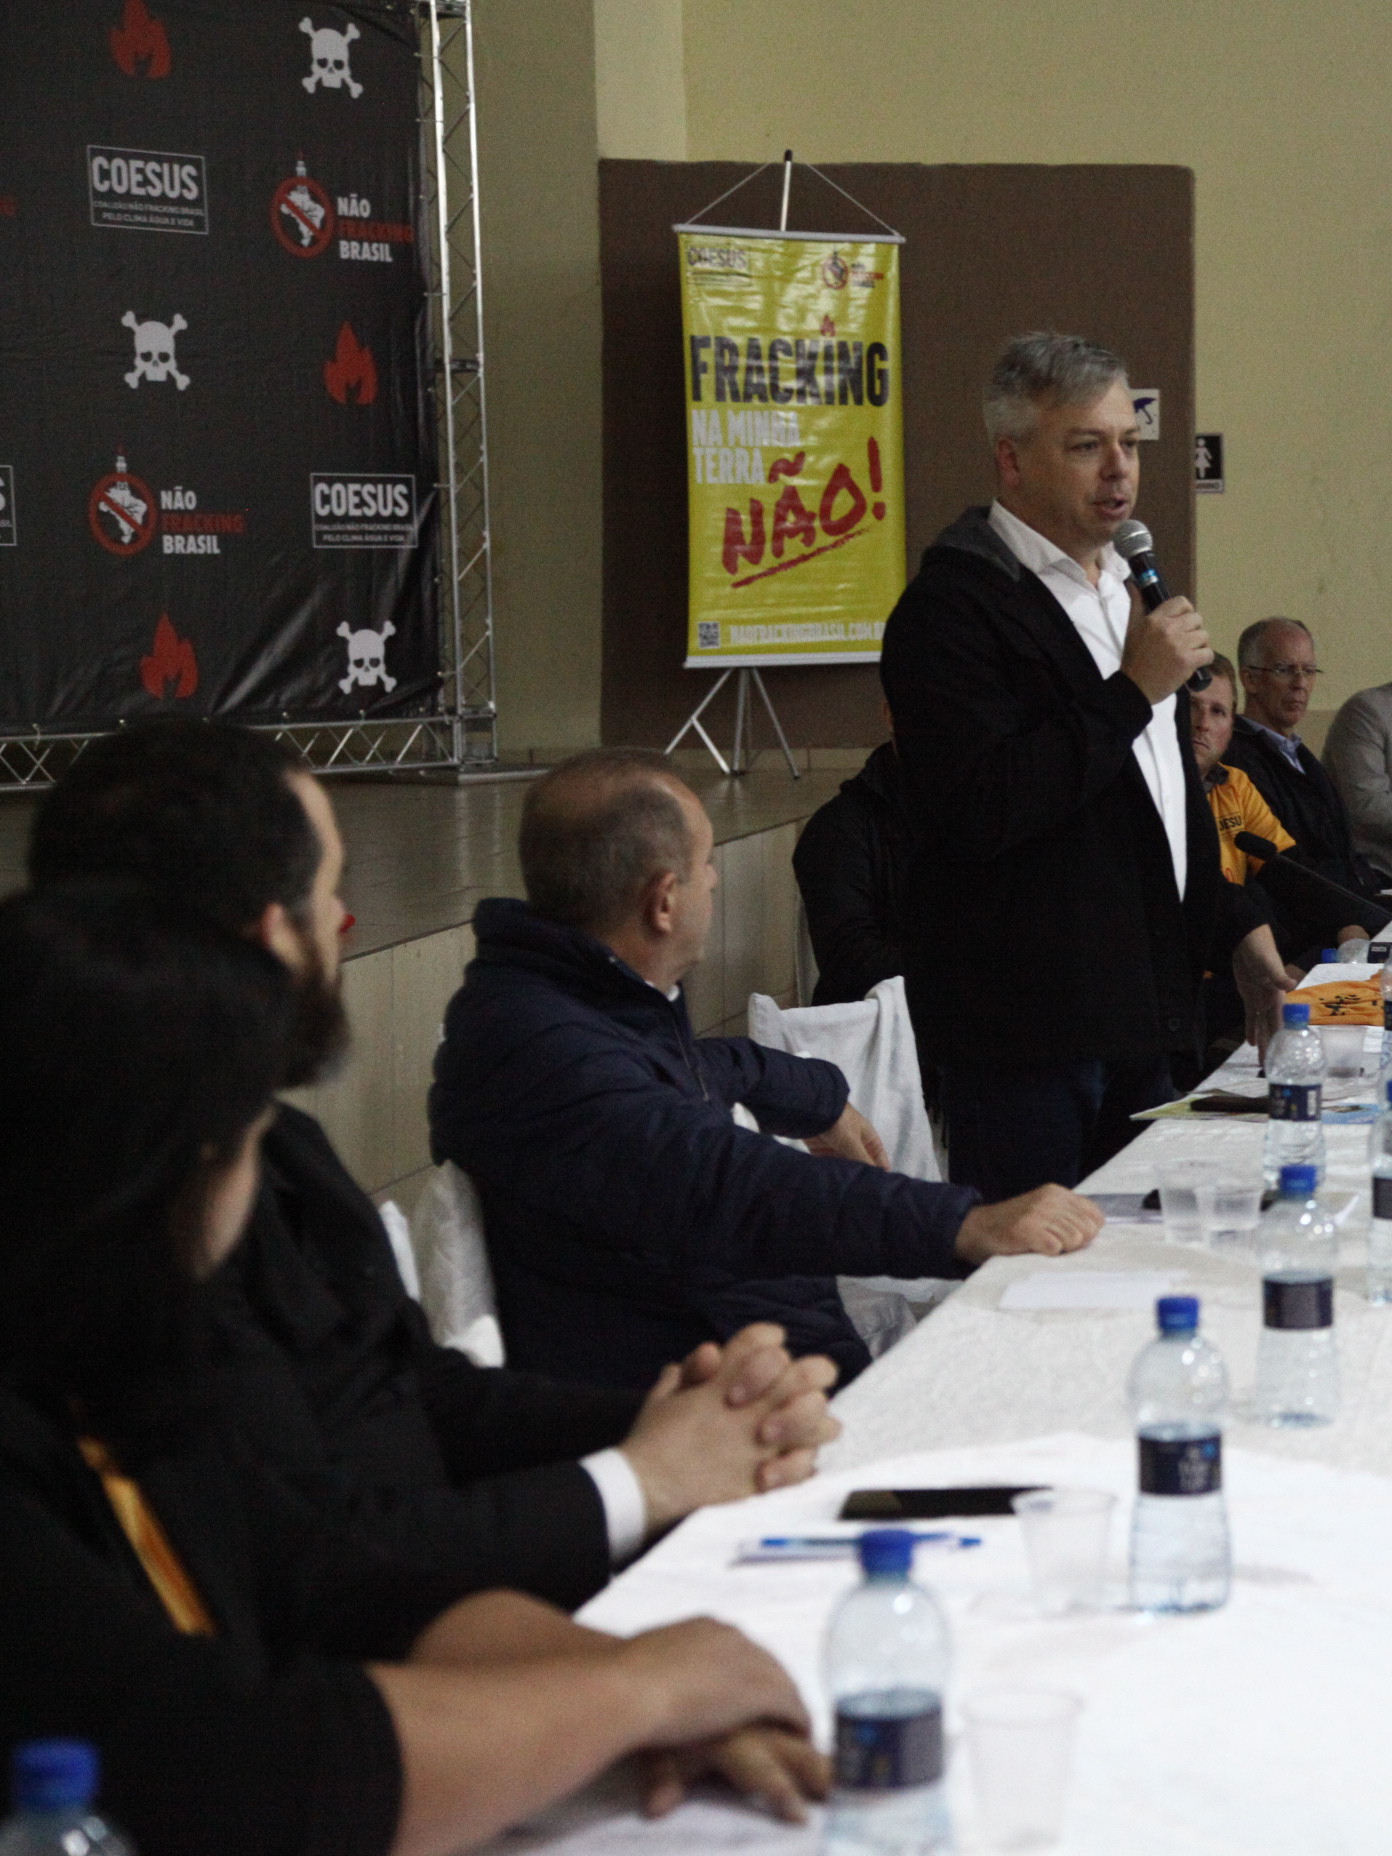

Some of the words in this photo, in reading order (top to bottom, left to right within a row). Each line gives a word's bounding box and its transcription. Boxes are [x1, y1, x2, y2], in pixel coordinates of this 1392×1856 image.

[91, 156, 199, 200] COESUS
[337, 193, 371, 218] NÃO
[339, 240, 393, 262] BRASIL
[690, 335, 889, 407] FRACKING
[691, 409, 722, 446] NA
[728, 410, 801, 447] MINHA
[693, 447, 766, 484] TERRA
[160, 486, 197, 510] NÃO
[314, 482, 409, 518] COESUS
[721, 435, 887, 576] NÃO!
[162, 535, 221, 554] BRASIL
